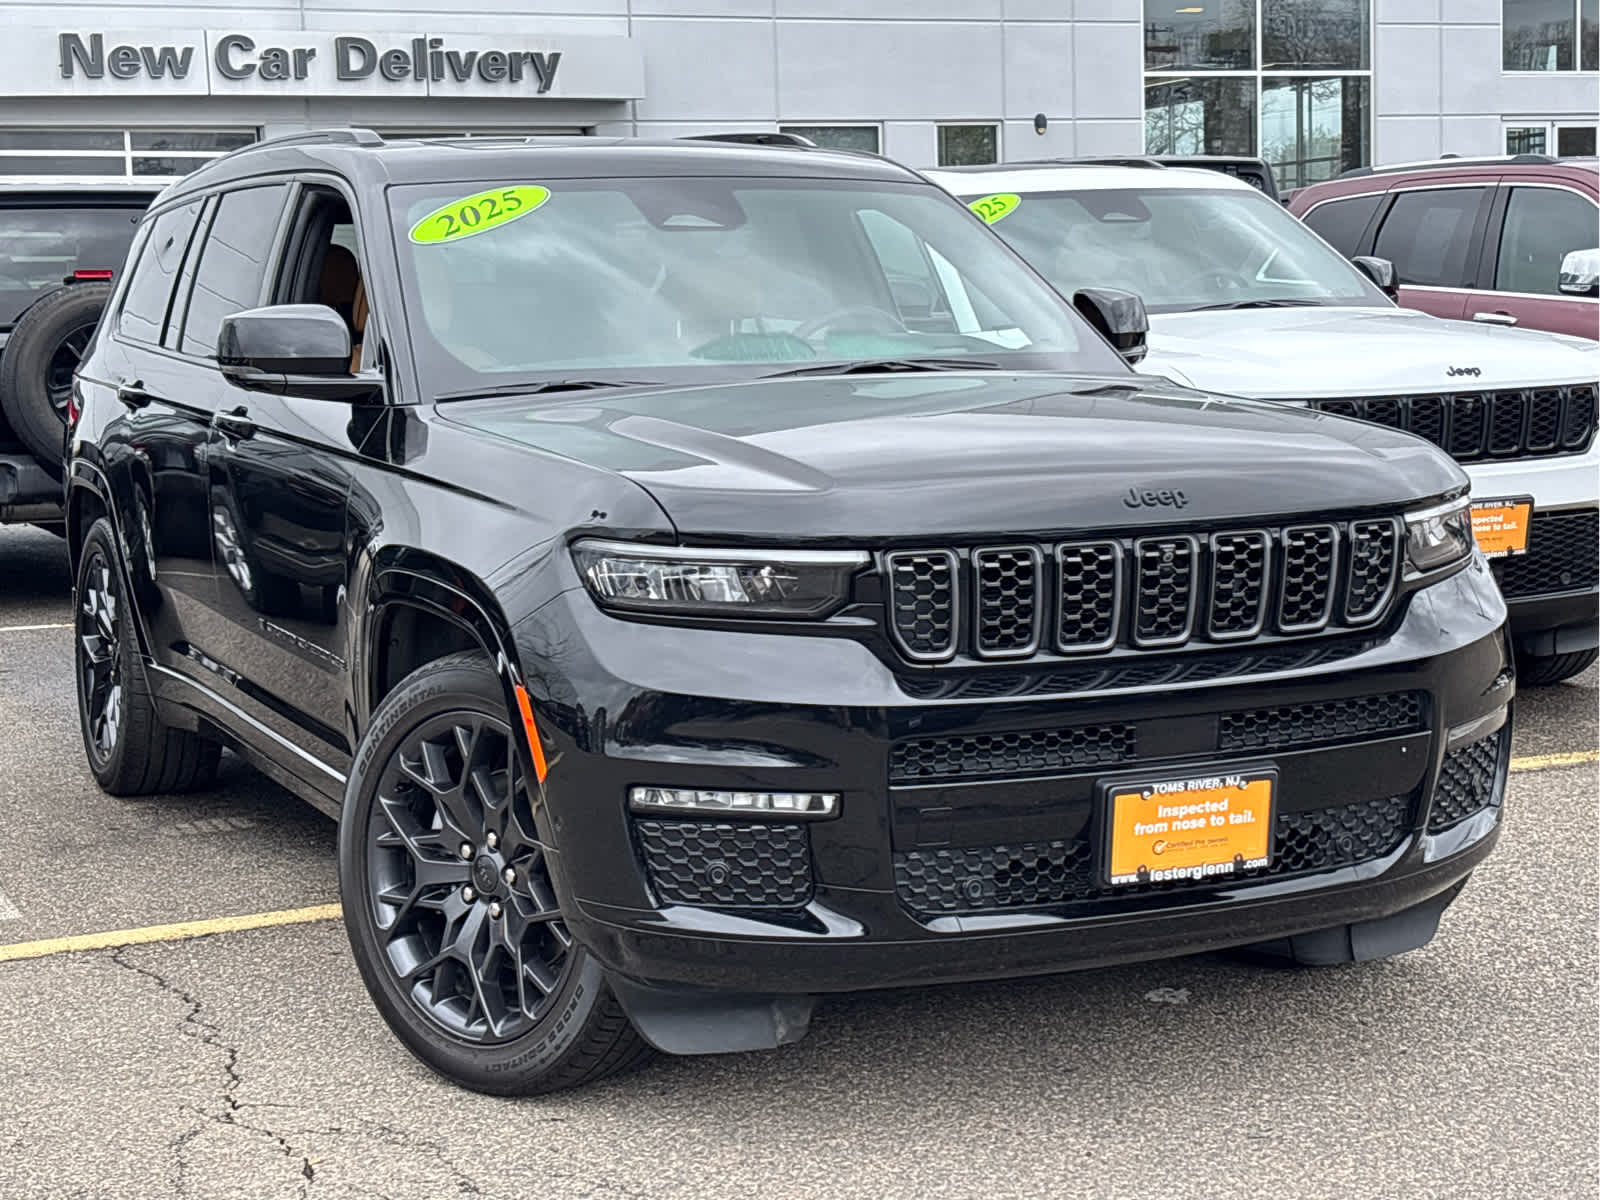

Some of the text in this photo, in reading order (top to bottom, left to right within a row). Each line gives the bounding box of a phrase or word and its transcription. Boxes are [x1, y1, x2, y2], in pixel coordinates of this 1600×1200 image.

[58, 33, 562, 94] New Car Delivery
[435, 190, 523, 237] 2025
[974, 197, 1007, 221] 25
[1446, 365, 1481, 378] Jeep
[1122, 488, 1190, 509] Jeep
[358, 684, 448, 777] CONTINENTAL
[1152, 775, 1241, 795] TOMS RIVER, NJ
[1158, 797, 1229, 819] Inspected
[1134, 809, 1257, 836] from nose to tail.
[1111, 857, 1269, 885] www. lesterglenn .com
